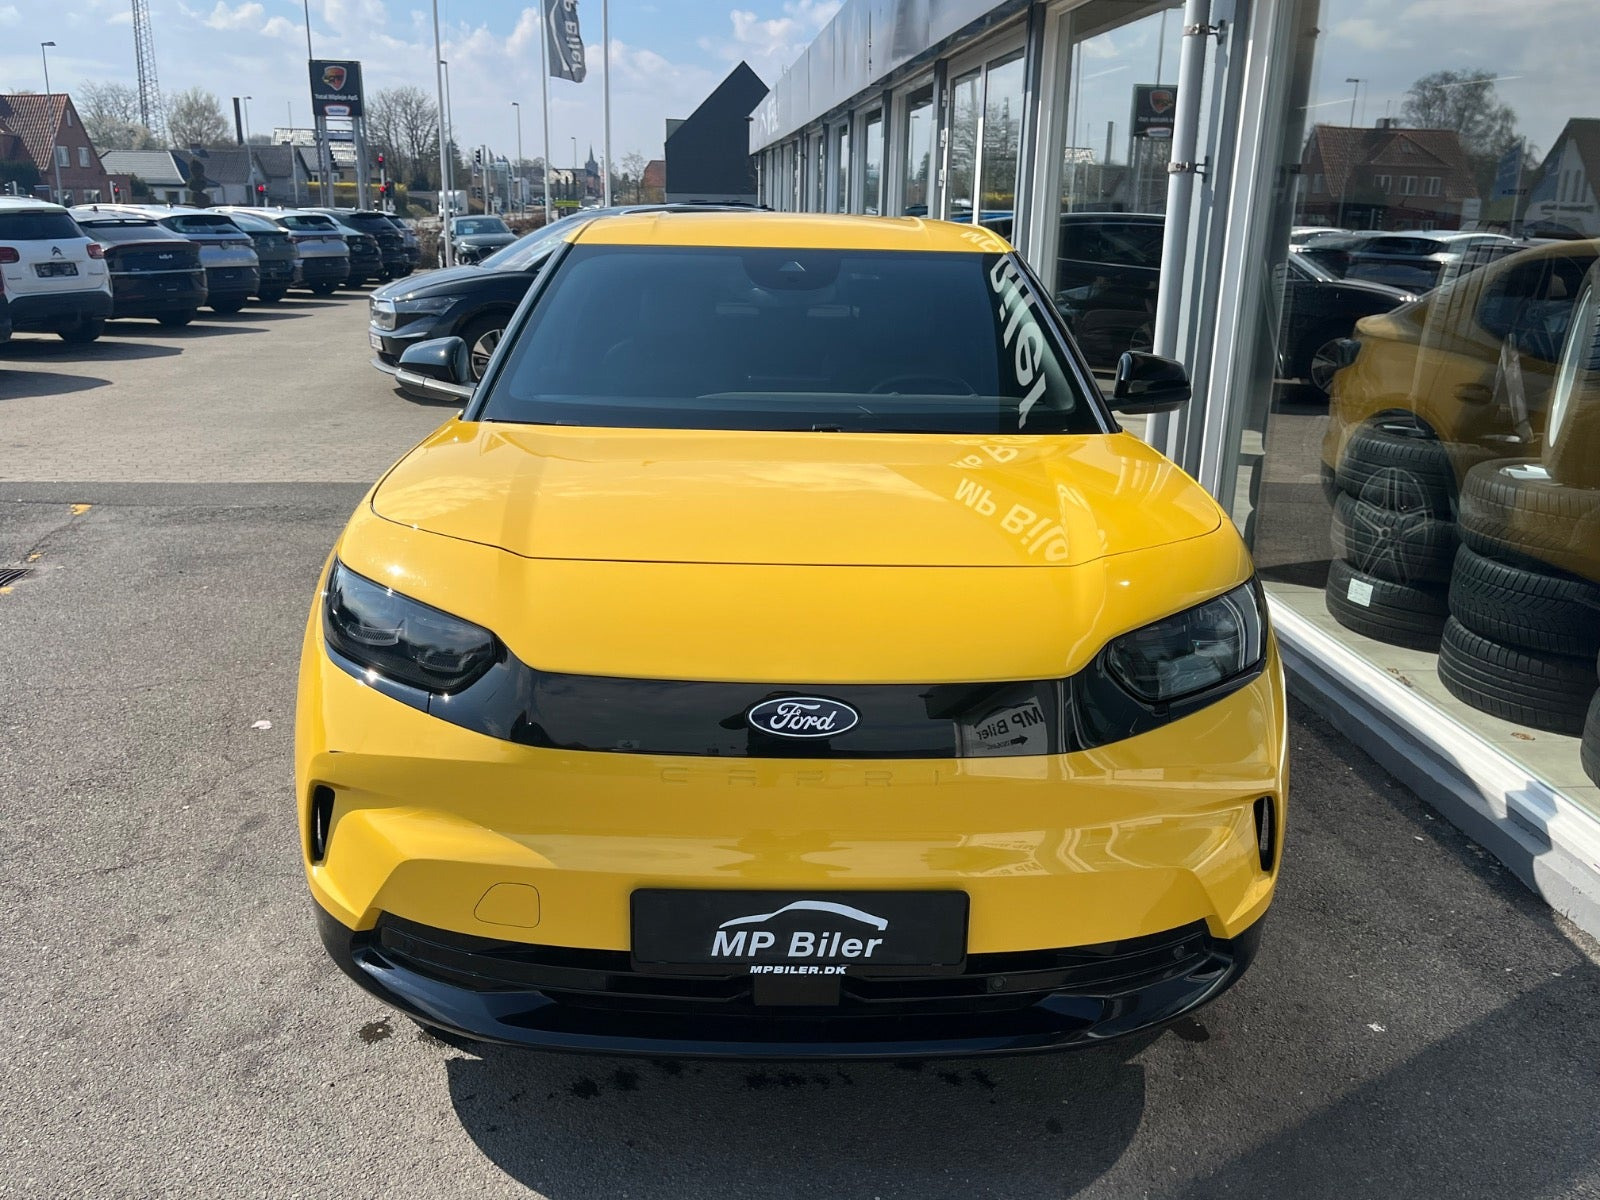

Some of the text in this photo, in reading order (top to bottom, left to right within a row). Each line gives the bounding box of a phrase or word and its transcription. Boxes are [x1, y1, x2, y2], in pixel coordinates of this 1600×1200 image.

[769, 702, 838, 730] Ford
[660, 767, 939, 787] CAPRI
[711, 931, 883, 958] MP Biler
[749, 965, 847, 975] MPBILER.DK
